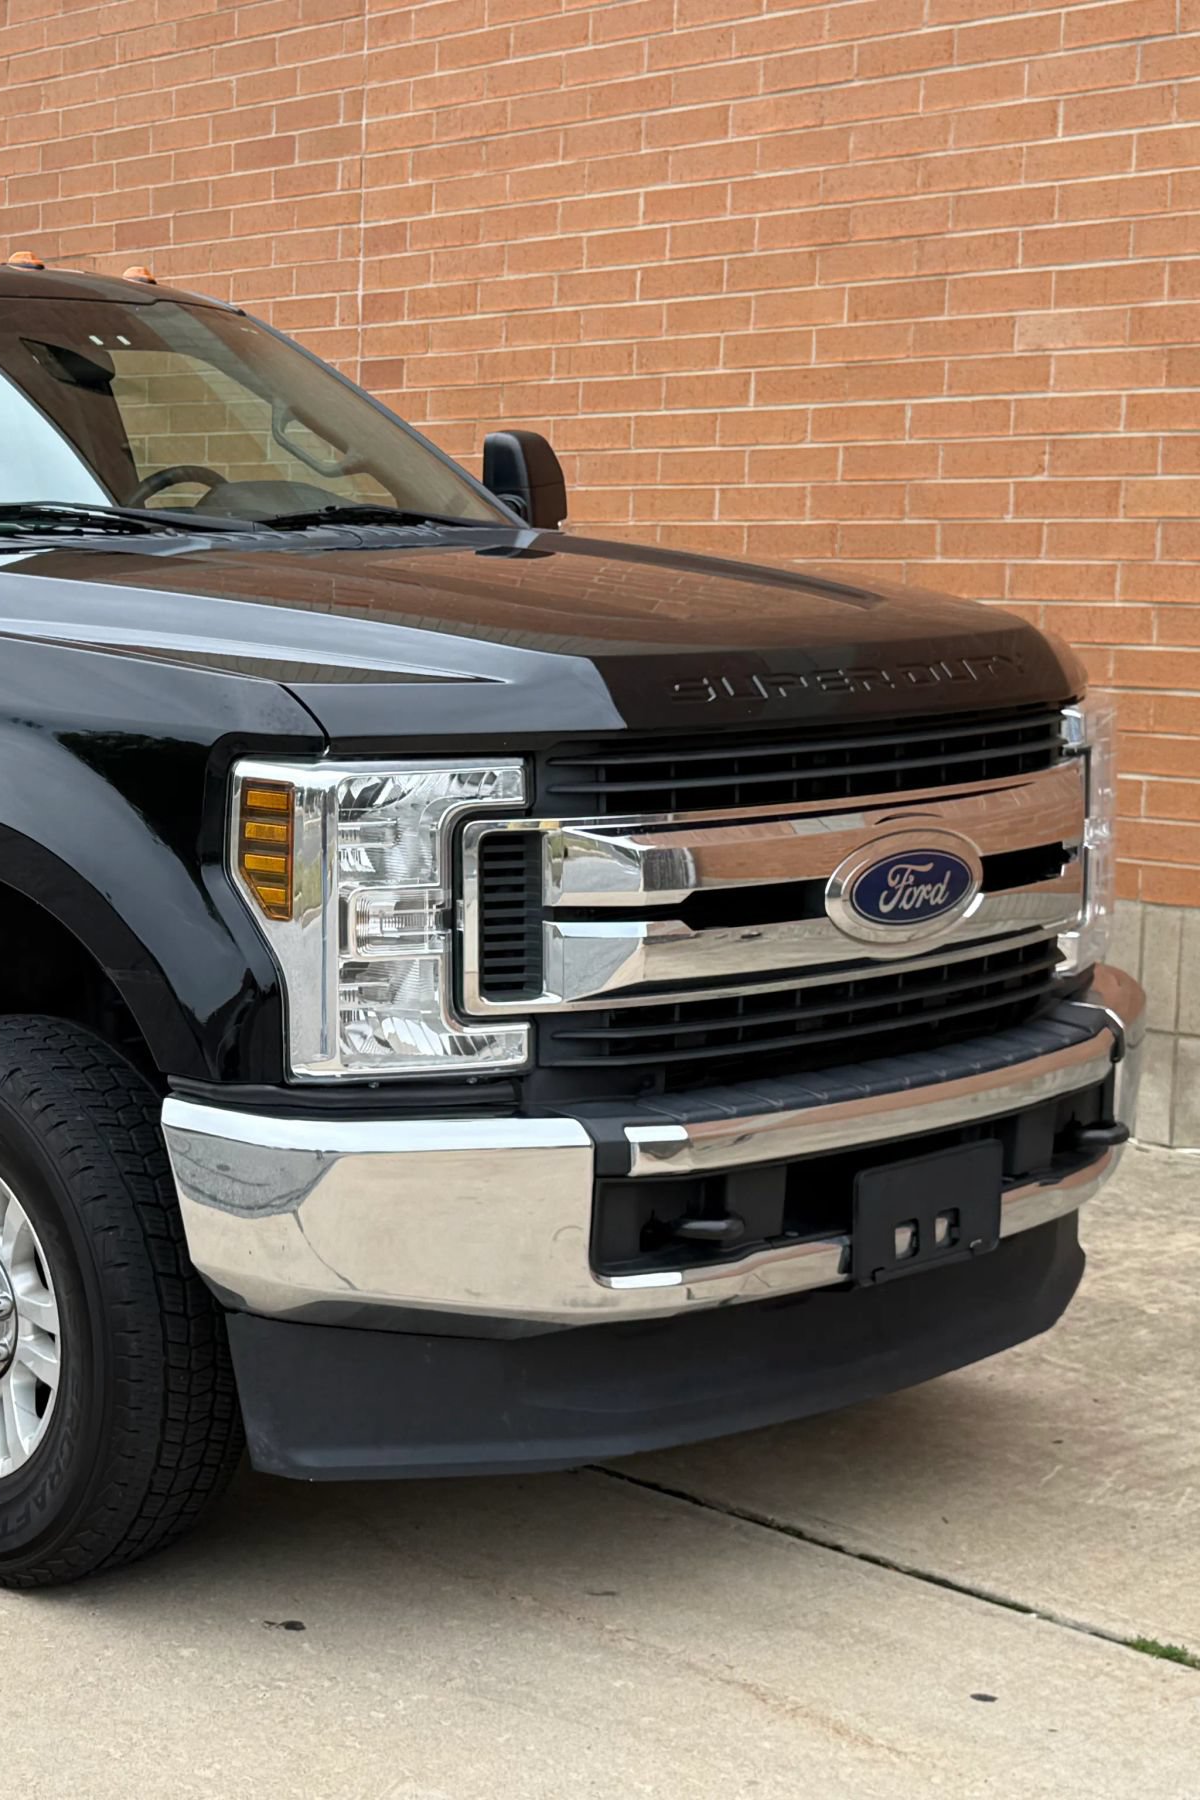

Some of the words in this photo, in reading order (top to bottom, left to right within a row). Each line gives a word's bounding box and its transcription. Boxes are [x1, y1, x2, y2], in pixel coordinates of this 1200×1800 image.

[669, 667, 896, 704] SUPER
[898, 652, 1025, 686] DUTY
[878, 862, 951, 914] Ford
